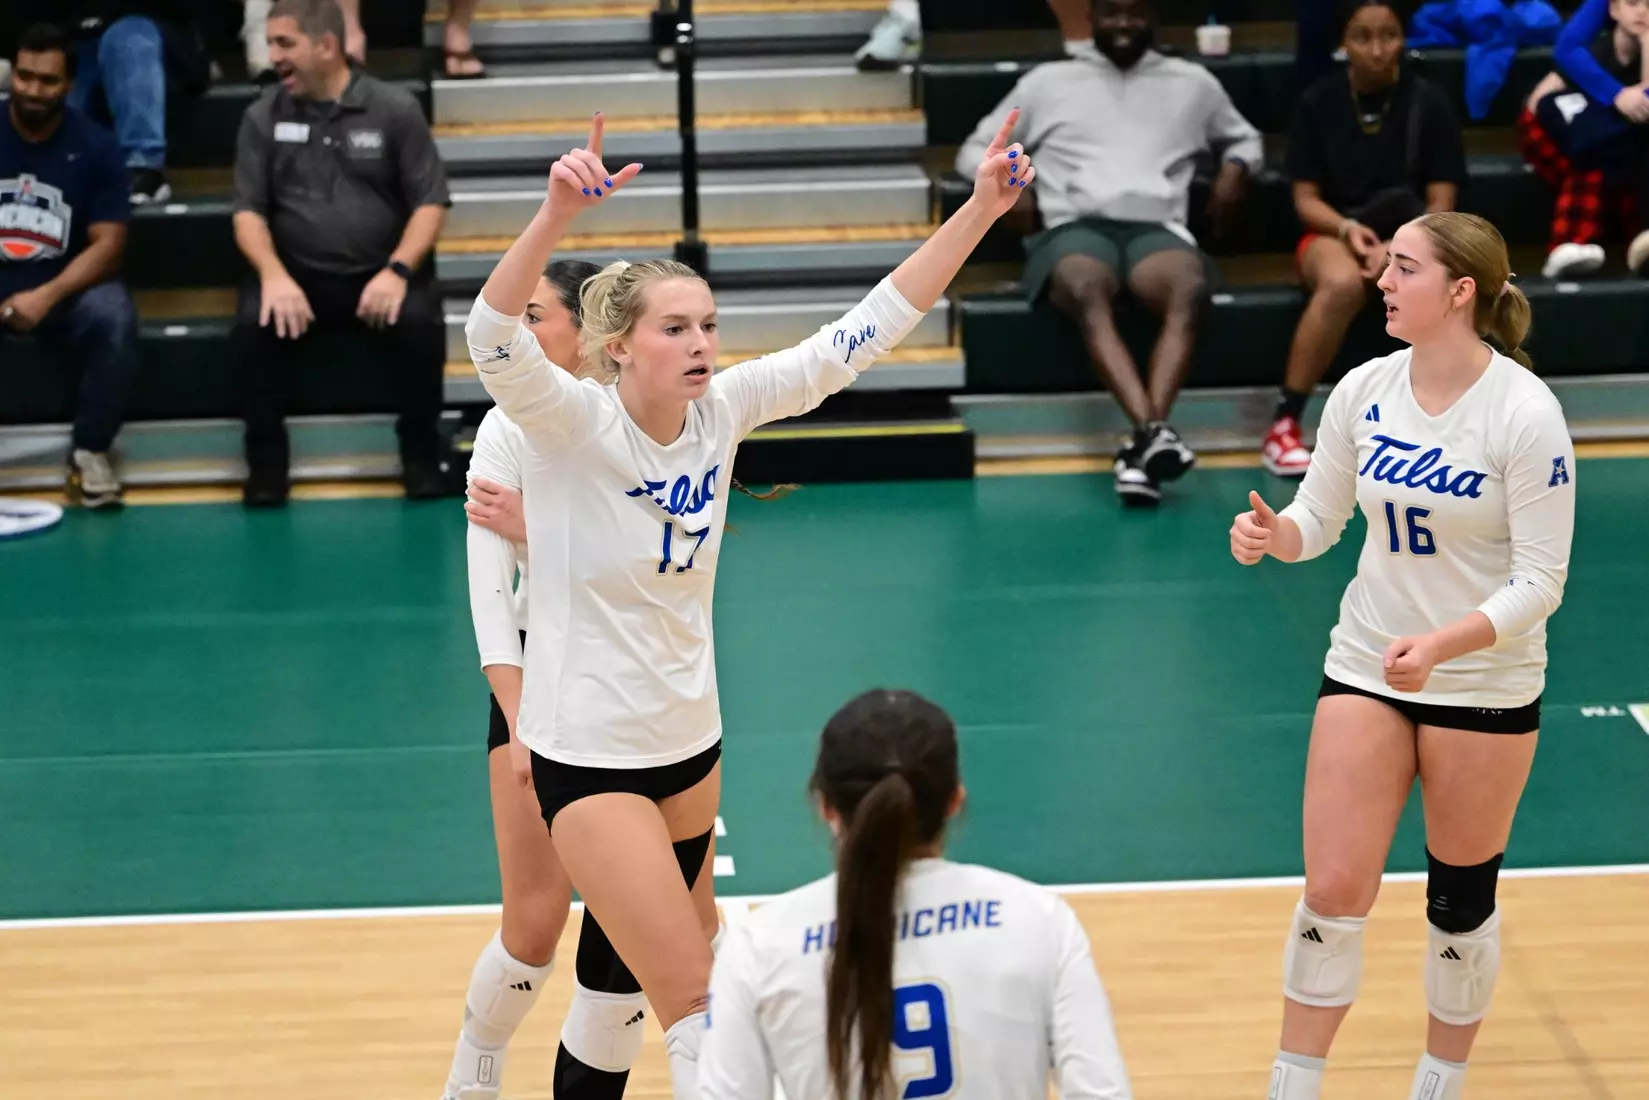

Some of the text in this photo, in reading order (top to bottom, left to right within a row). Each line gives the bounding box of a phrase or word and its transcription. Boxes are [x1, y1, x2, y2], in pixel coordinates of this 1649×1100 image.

[624, 464, 720, 518] Tlsa
[1359, 434, 1488, 499] Tulsa
[656, 519, 711, 575] 17
[1383, 499, 1437, 556] 16
[802, 900, 1003, 955] HICANE
[889, 982, 955, 1099] 9
